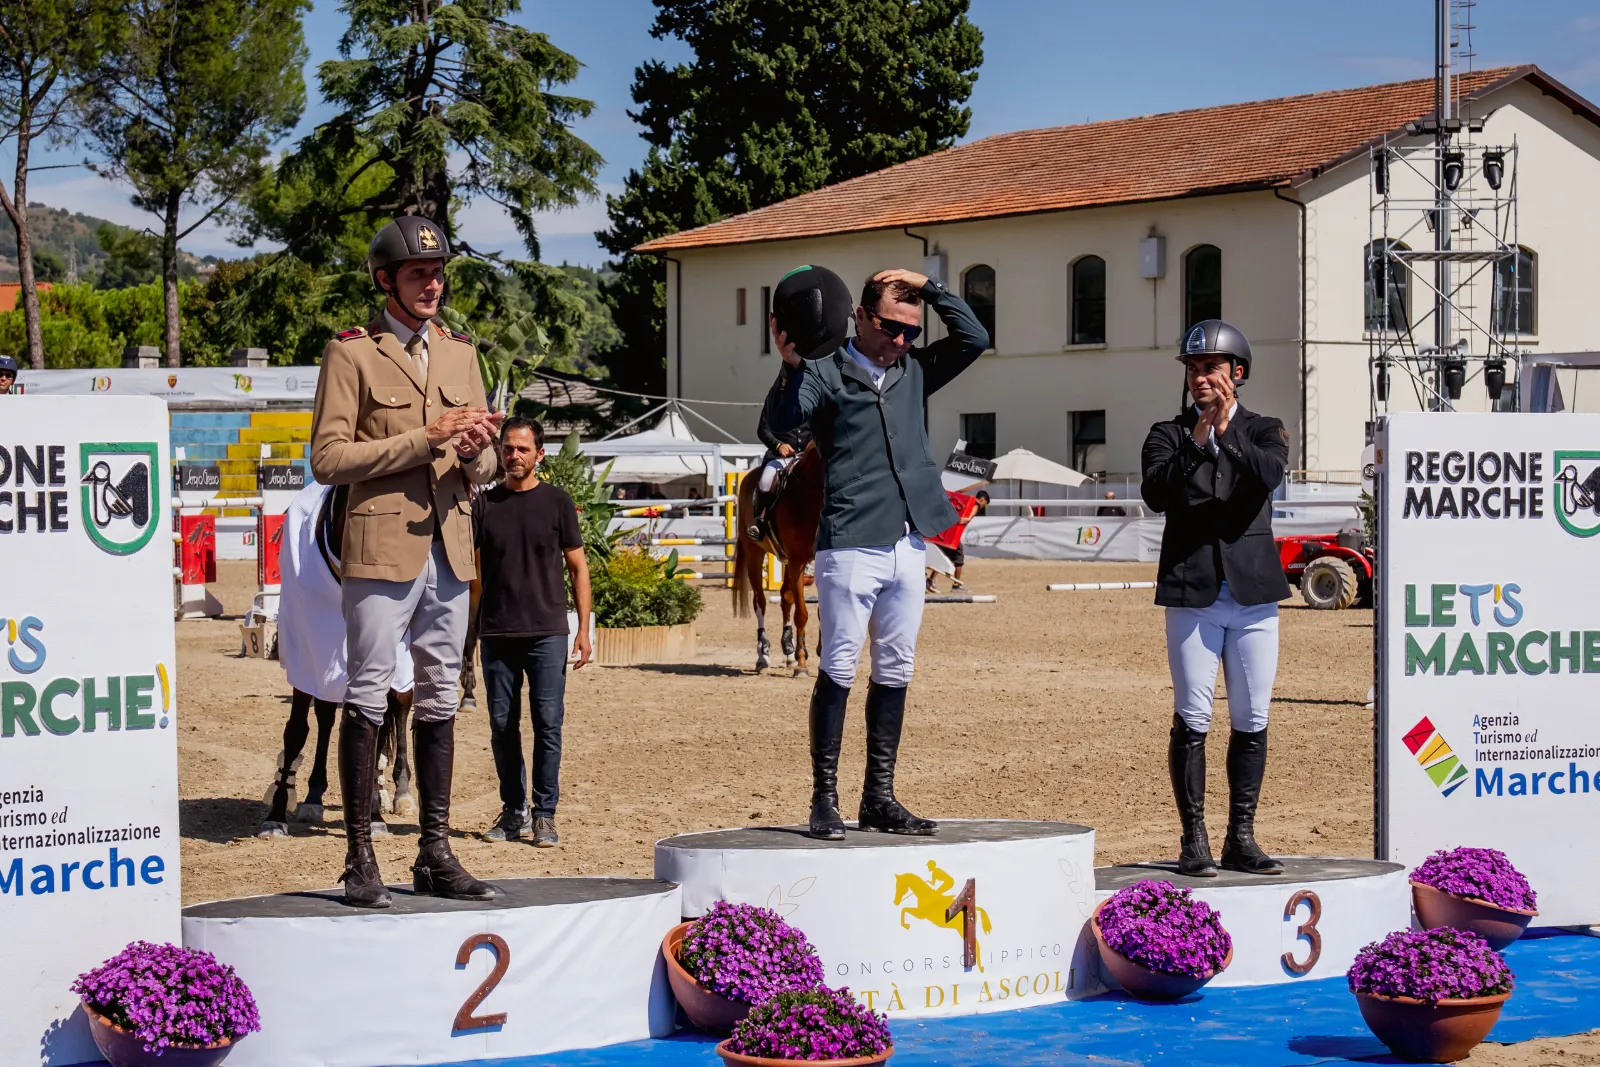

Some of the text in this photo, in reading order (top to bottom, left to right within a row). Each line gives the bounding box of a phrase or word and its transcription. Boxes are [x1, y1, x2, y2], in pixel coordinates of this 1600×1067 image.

[1405, 450, 1543, 484] REGIONE
[1402, 486, 1544, 519] MARCHE
[1405, 582, 1523, 627] LET'S
[0, 616, 47, 675] 'S
[1405, 630, 1600, 676] MARCHE
[1472, 712, 1520, 730] Agenzia
[1473, 729, 1538, 745] Turismo ed
[0, 785, 44, 809] enzia
[0, 806, 68, 829] rismo ed
[0, 824, 161, 851] ternazionalizzazione
[945, 877, 976, 968] 1
[1282, 889, 1322, 974] 3
[837, 943, 1061, 976] ONCORS IPPICO
[452, 932, 511, 1033] 2
[924, 983, 960, 1008] DI
[978, 968, 1077, 1002] ASCOLI
